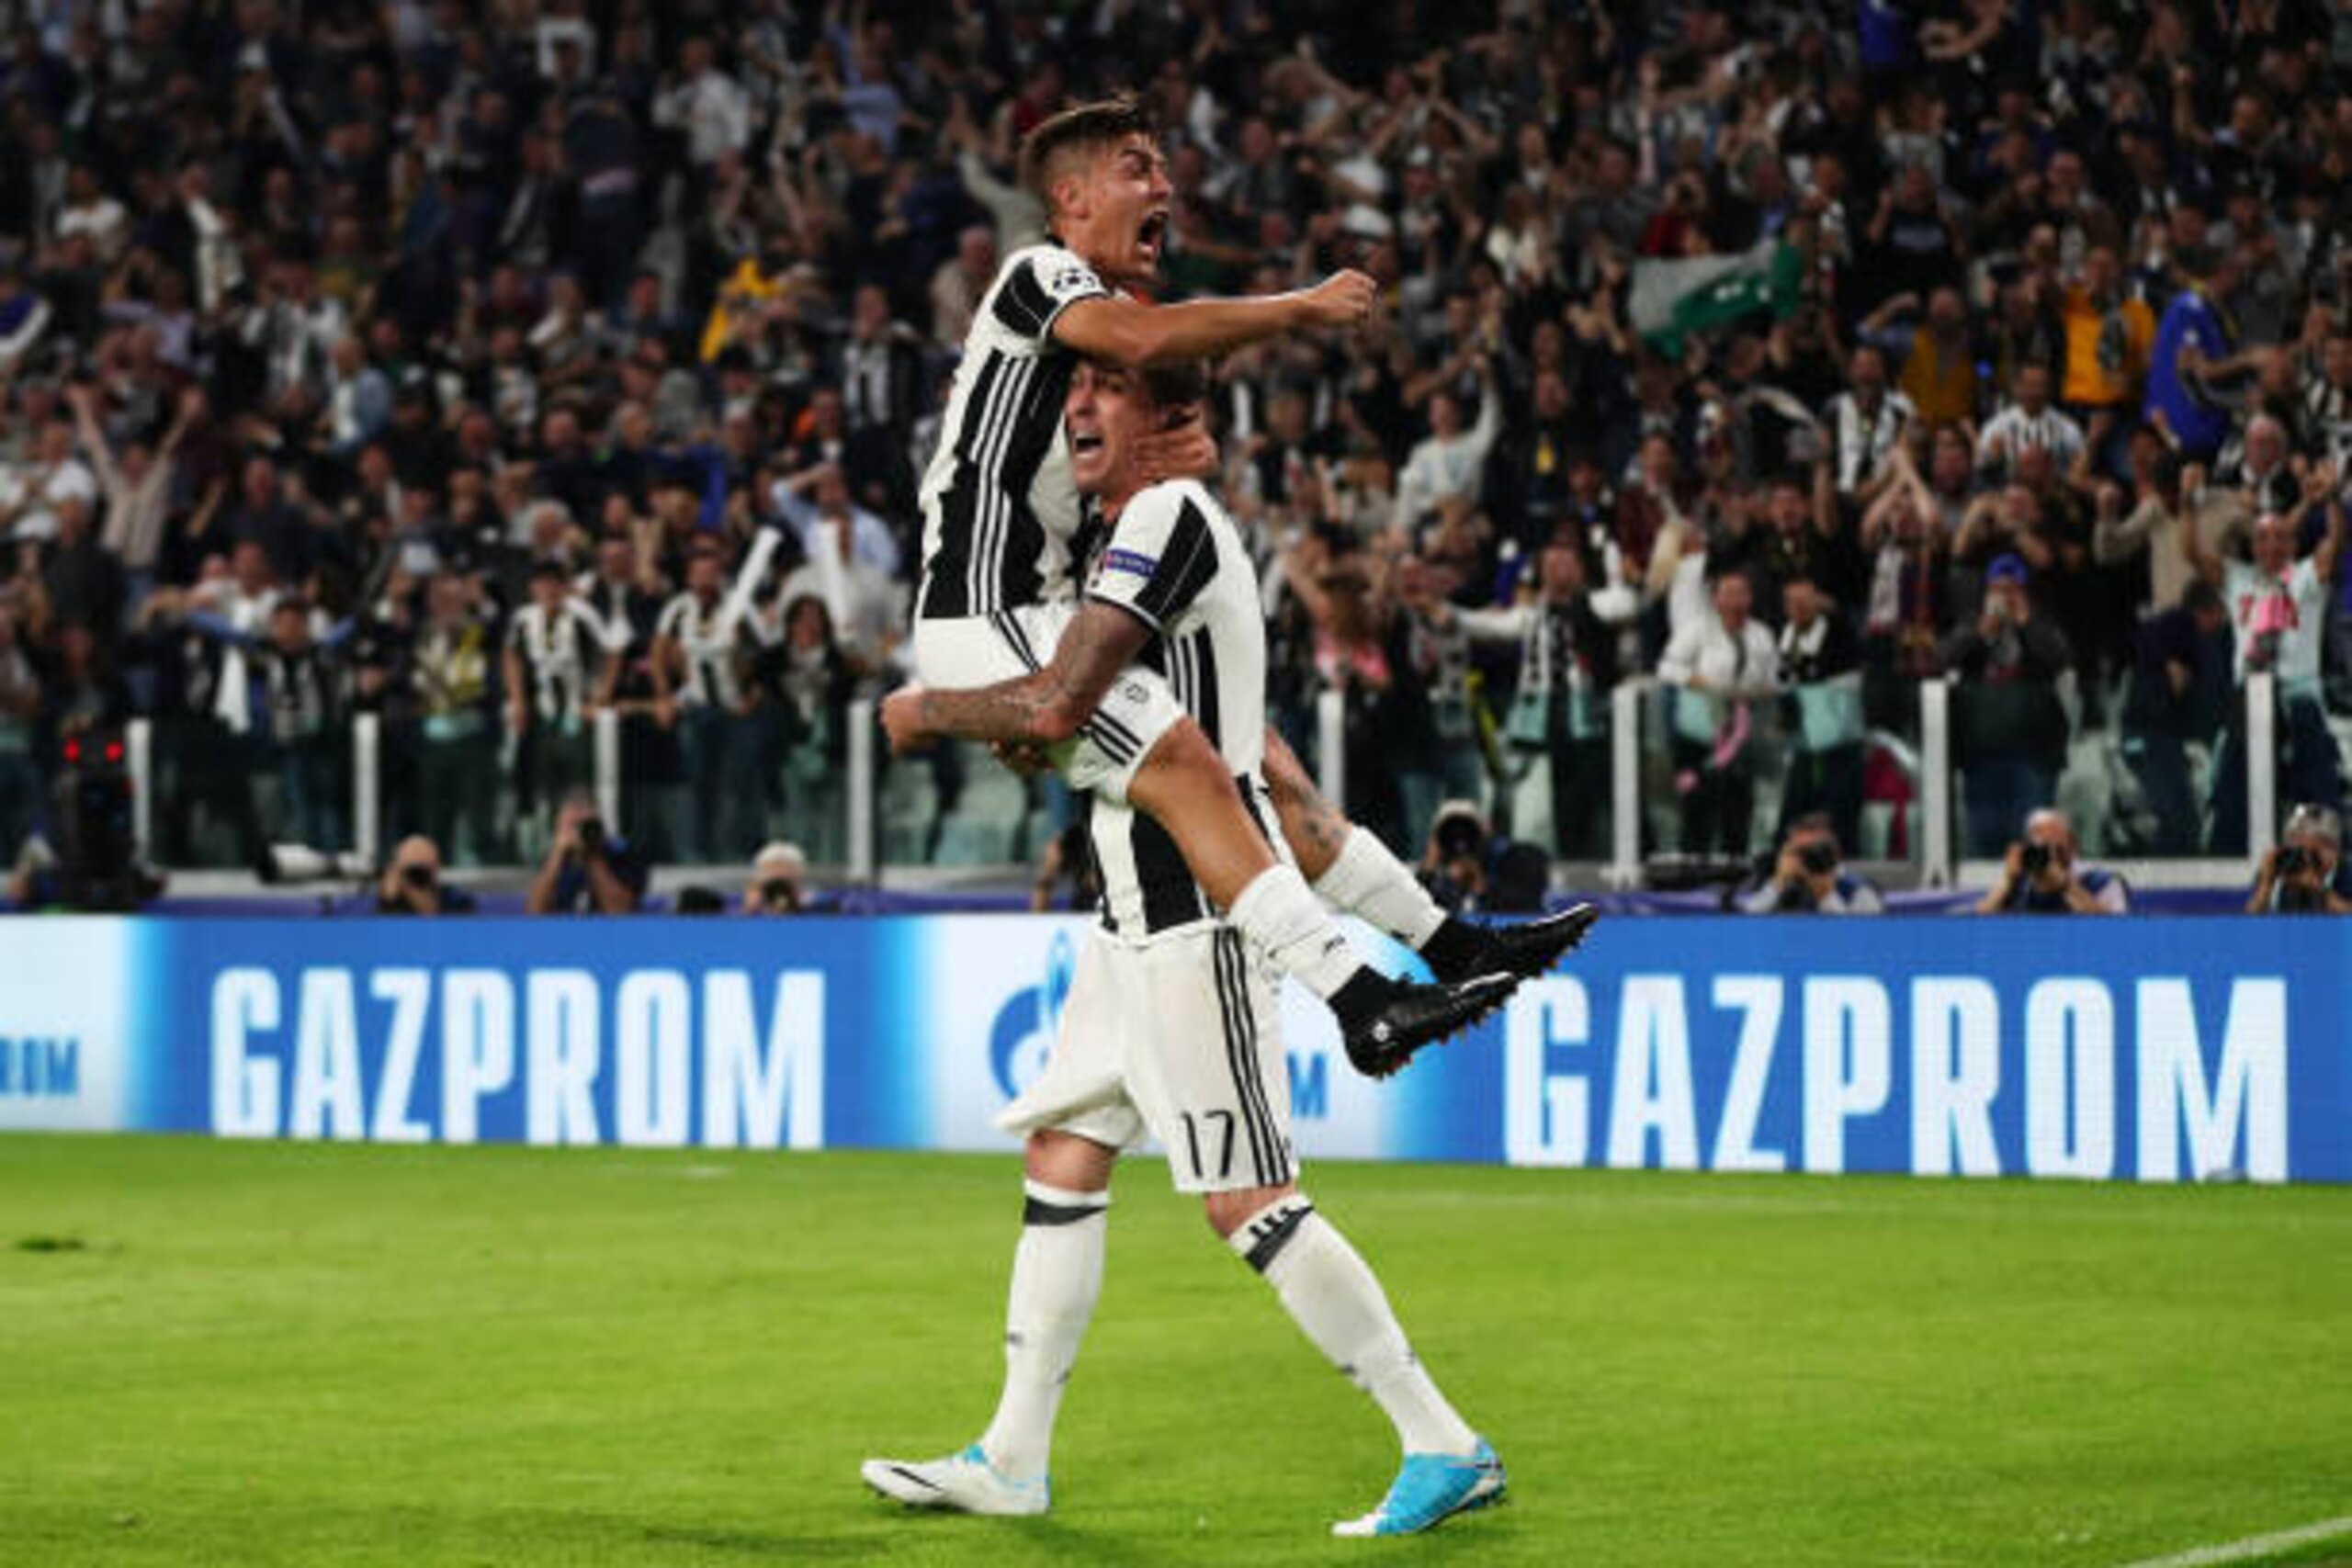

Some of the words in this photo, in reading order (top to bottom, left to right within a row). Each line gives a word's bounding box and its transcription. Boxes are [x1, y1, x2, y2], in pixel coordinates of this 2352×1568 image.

[211, 968, 825, 1149] GAZPROM
[1182, 1110, 1234, 1178] 17
[1505, 975, 2288, 1181] GAZPROM
